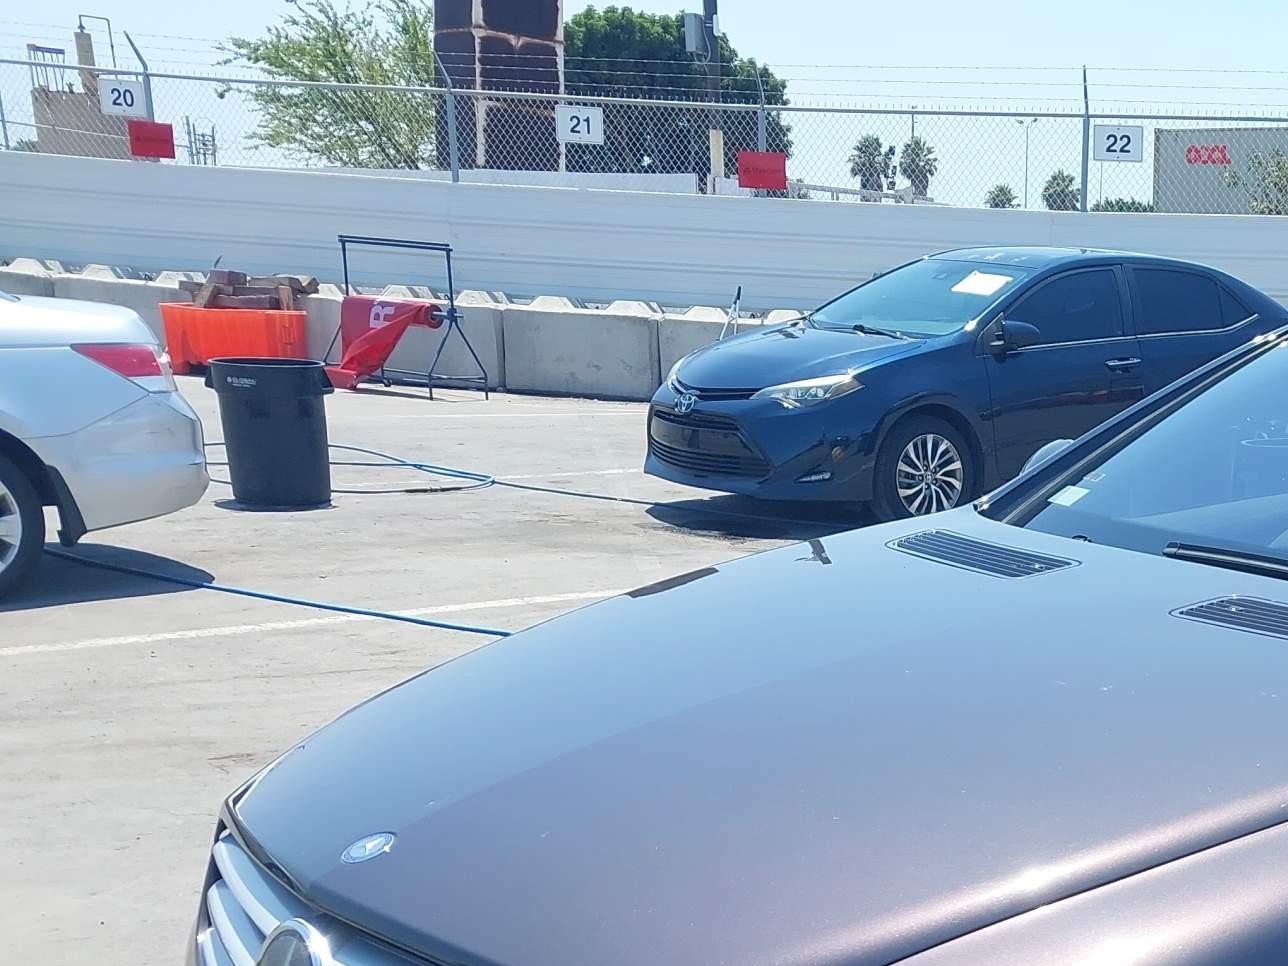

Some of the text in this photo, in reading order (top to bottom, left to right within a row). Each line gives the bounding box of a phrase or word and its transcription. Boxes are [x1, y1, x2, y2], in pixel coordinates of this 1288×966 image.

[110, 88, 135, 107] 20
[569, 115, 591, 135] 21
[1105, 133, 1131, 153] 22
